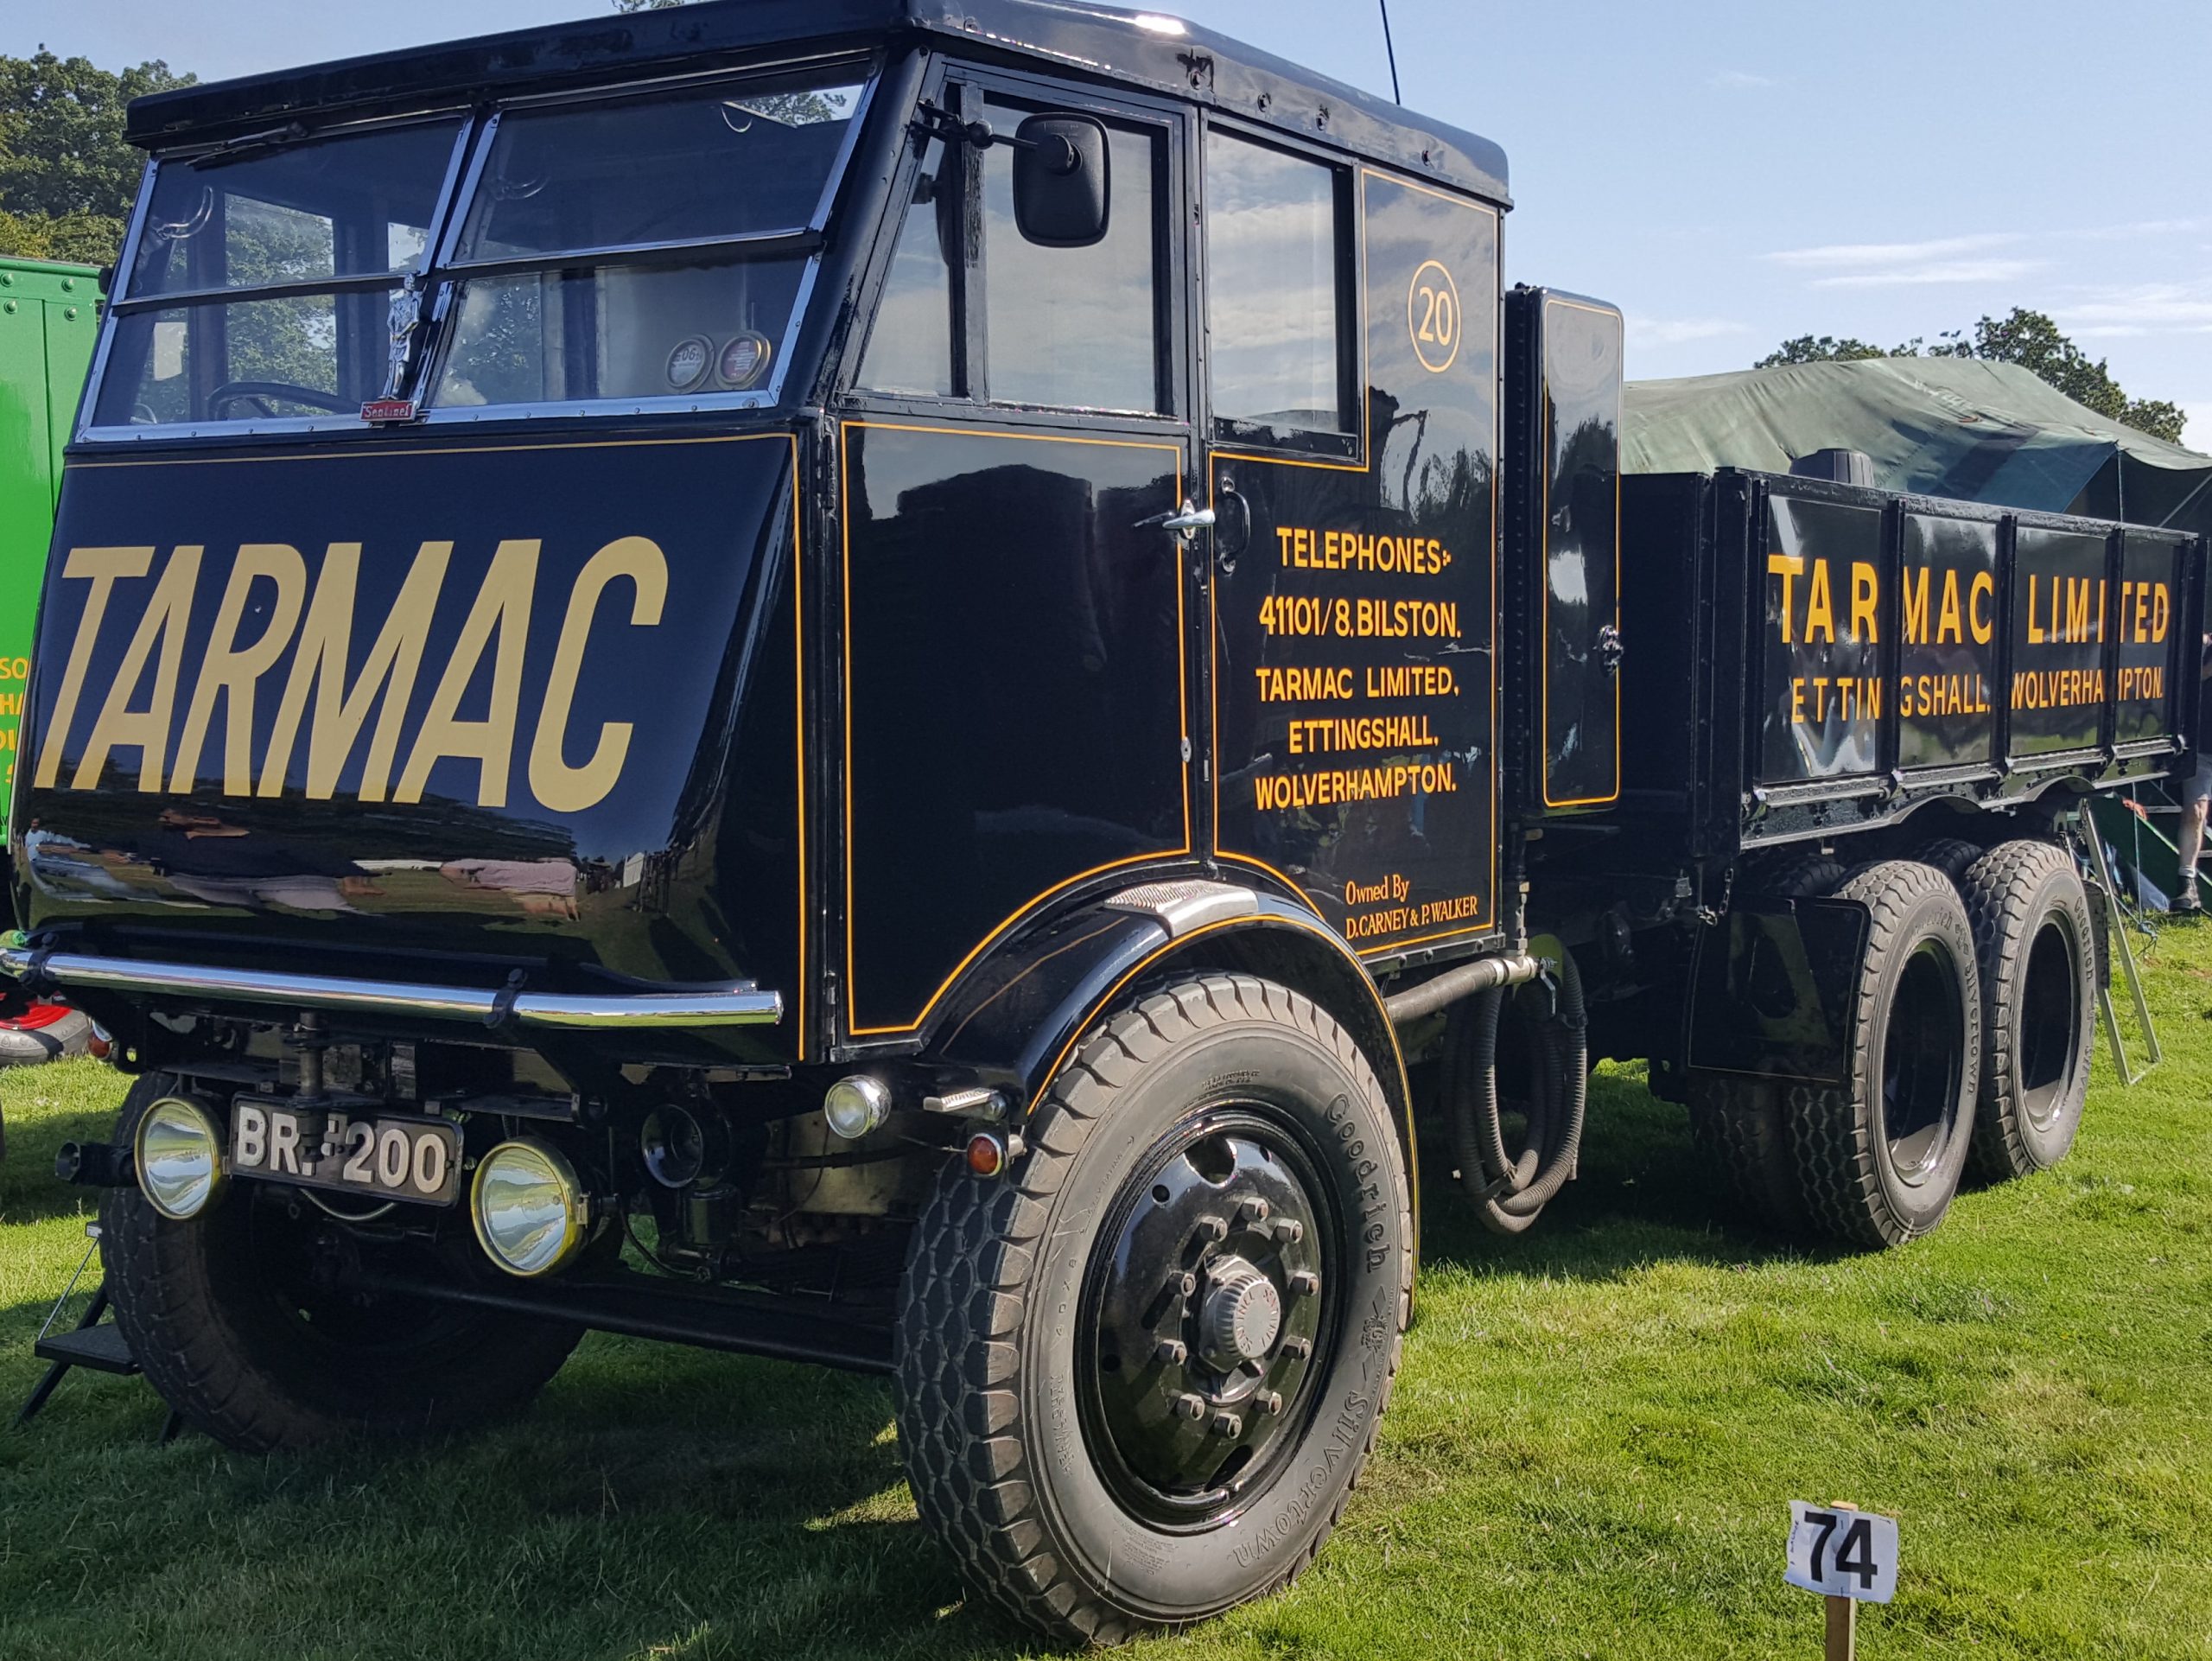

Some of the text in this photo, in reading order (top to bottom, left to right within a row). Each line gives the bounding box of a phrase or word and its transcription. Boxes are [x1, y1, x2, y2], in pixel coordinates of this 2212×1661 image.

[1418, 286, 1452, 346] 20
[1768, 554, 2169, 645] TARMAC LIMITED
[33, 536, 669, 812] TARMAC
[1255, 667, 1353, 702] TARMAC
[1255, 763, 1457, 811] WOLVERHAMPTON.
[1345, 873, 1410, 905] Owned By
[1410, 907, 1419, 927] &
[343, 1121, 447, 1193] 200
[1326, 1092, 1391, 1275] Goodrich
[1232, 1389, 1370, 1569] Silvertown
[1804, 1510, 1878, 1589] 74
